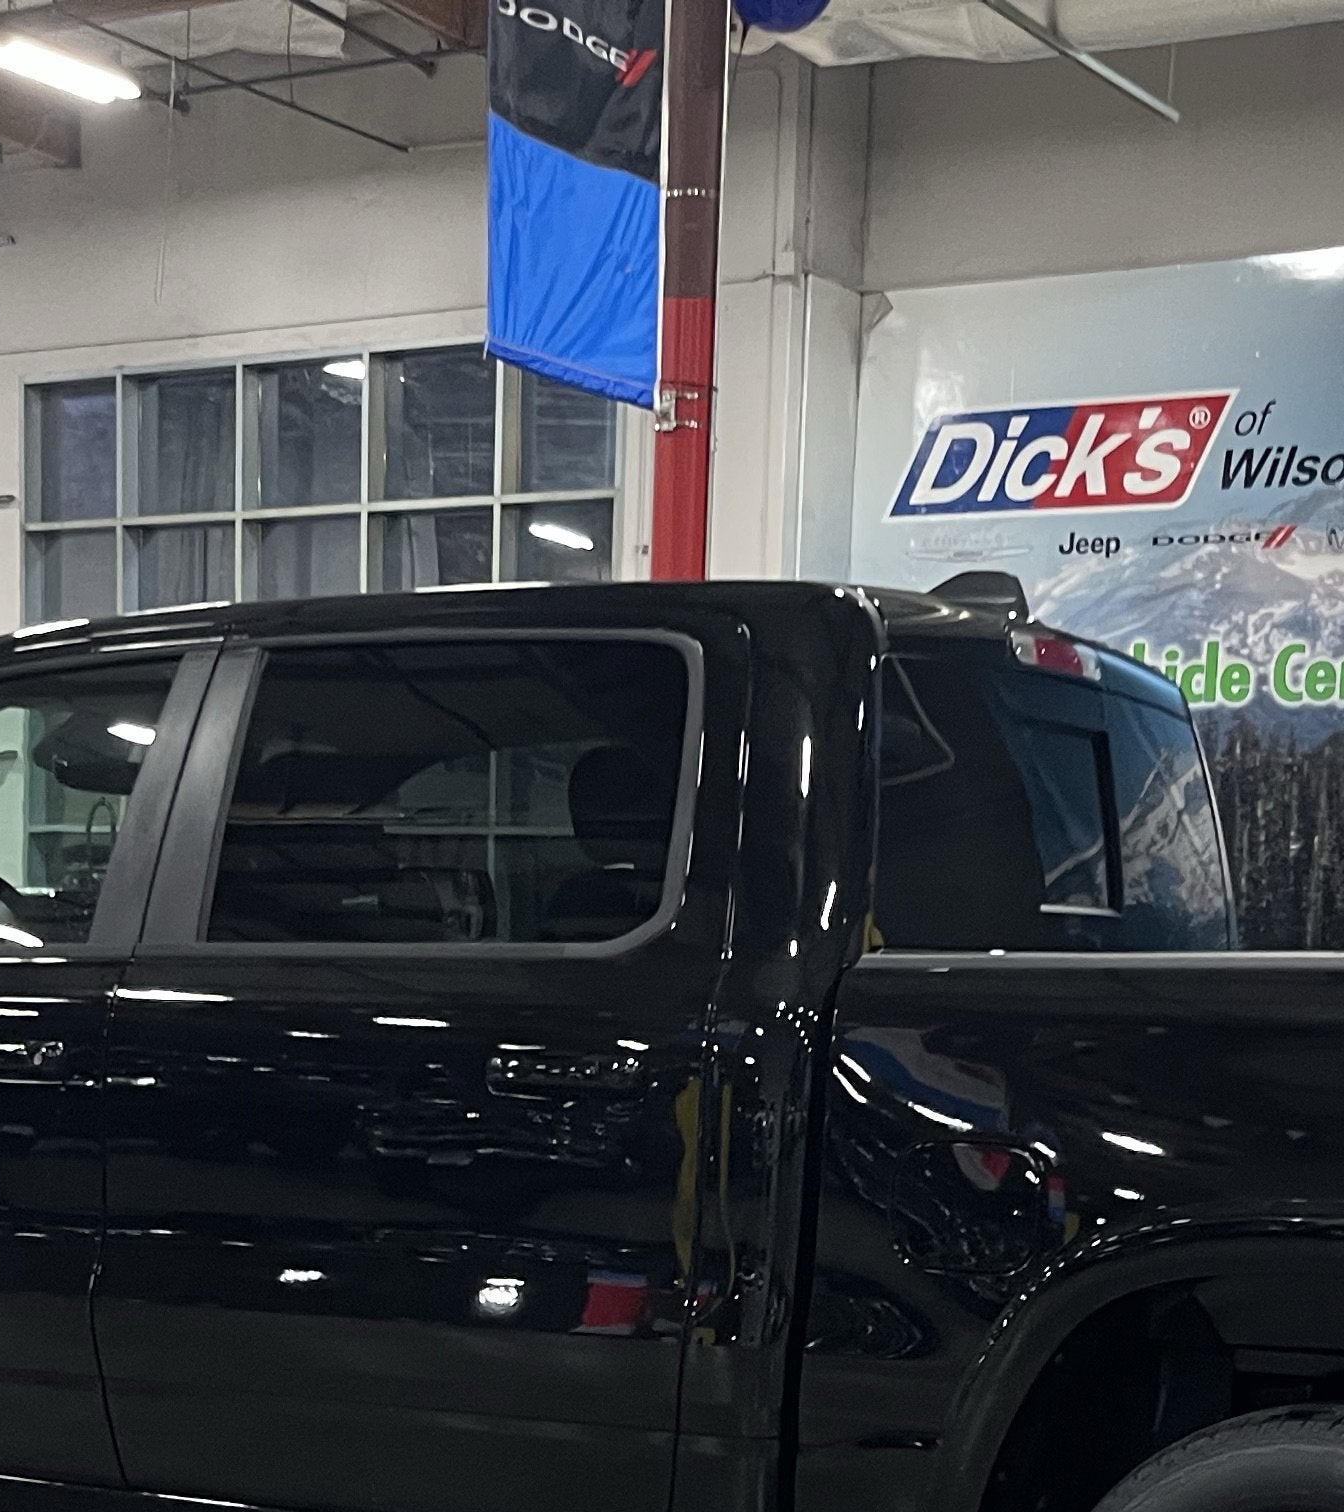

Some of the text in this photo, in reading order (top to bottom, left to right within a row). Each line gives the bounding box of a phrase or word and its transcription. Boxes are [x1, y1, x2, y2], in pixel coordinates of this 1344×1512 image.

[498, 0, 630, 73] DODGE
[1234, 400, 1276, 437] of
[909, 406, 1191, 505] Dick's
[1058, 532, 1121, 558] Jeep
